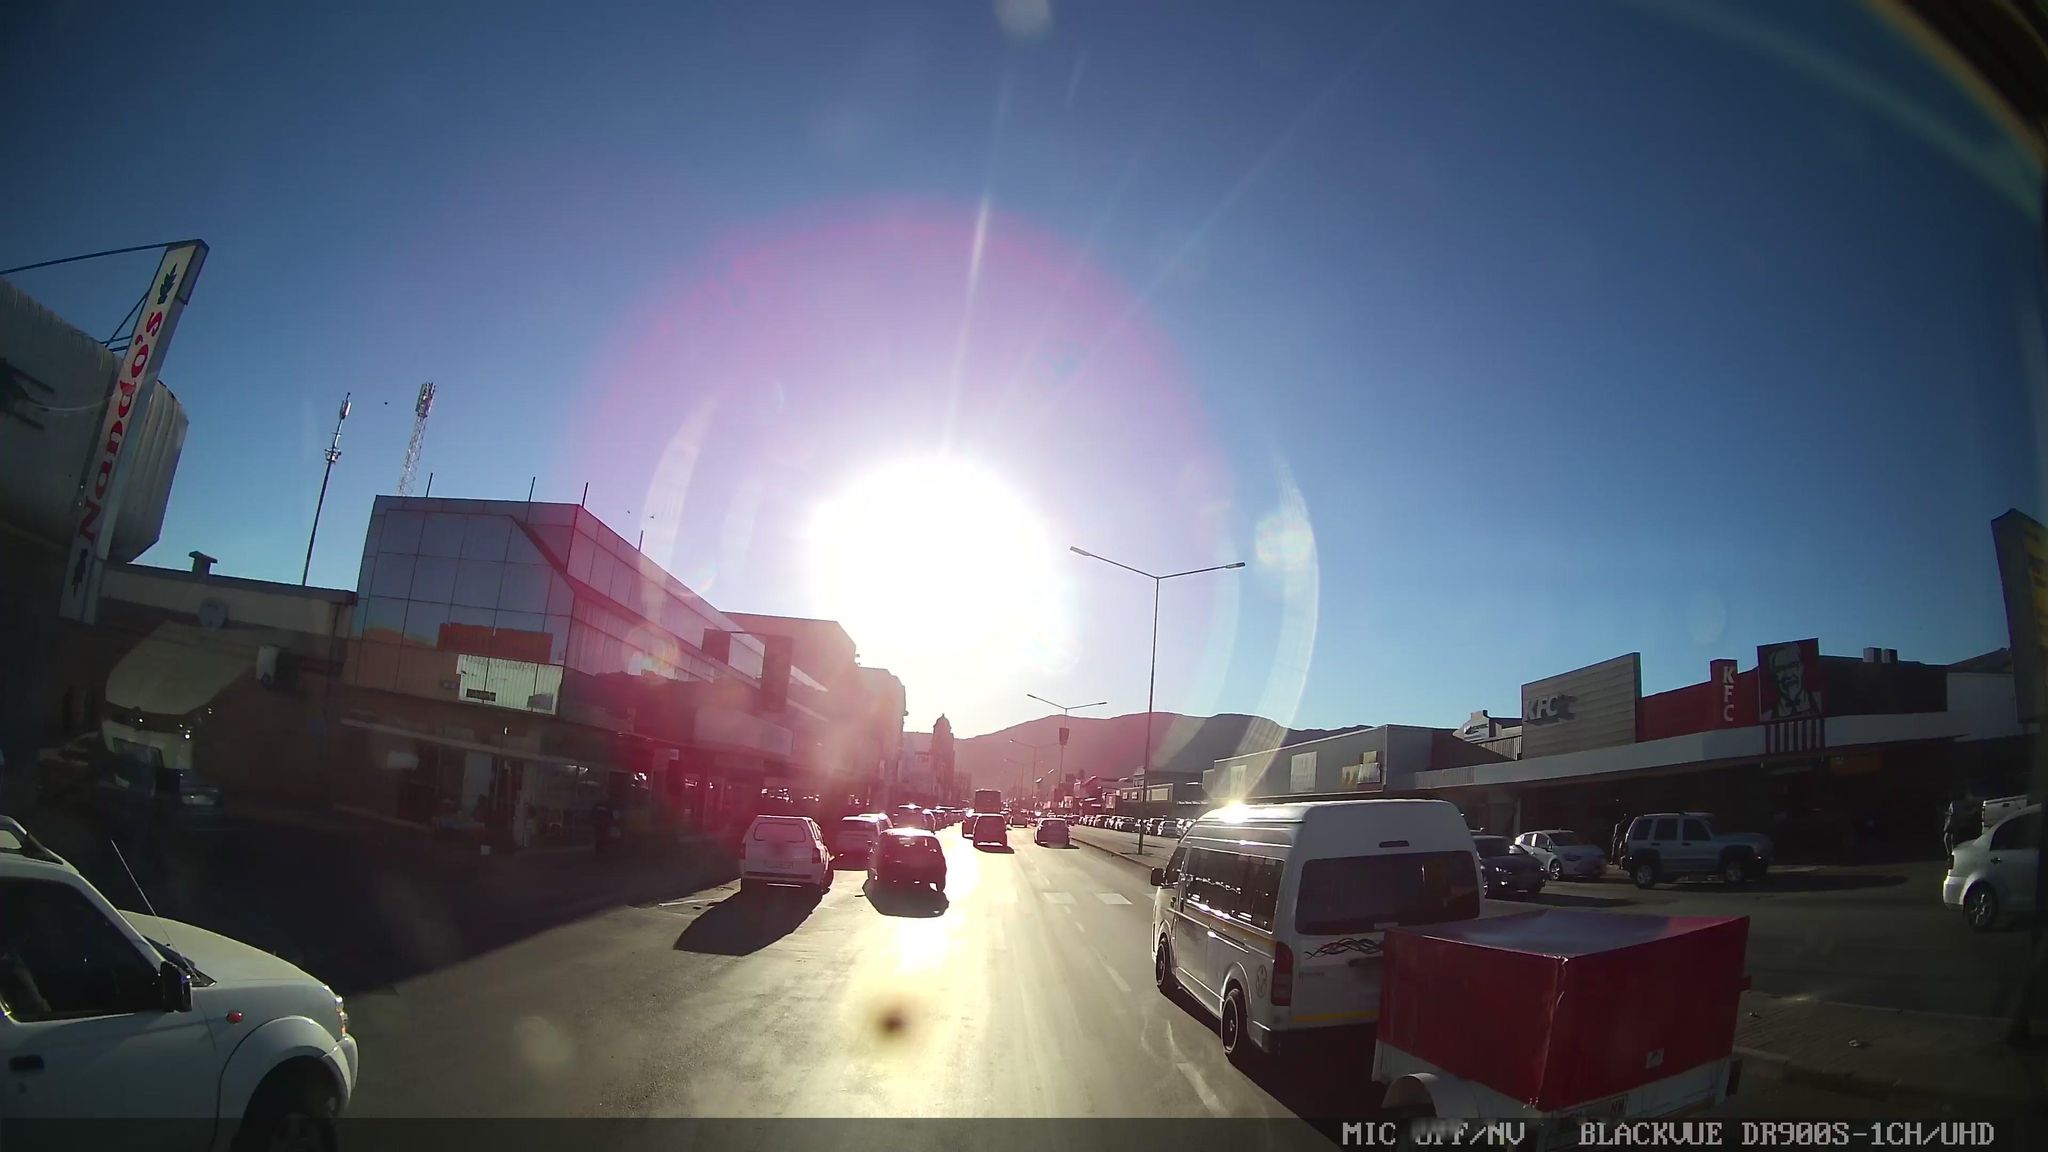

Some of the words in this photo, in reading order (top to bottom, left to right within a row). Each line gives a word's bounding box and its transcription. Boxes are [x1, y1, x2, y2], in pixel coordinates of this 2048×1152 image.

[79, 310, 163, 541] Nando's
[1526, 694, 1560, 721] KFC
[1723, 665, 1736, 722] KFC
